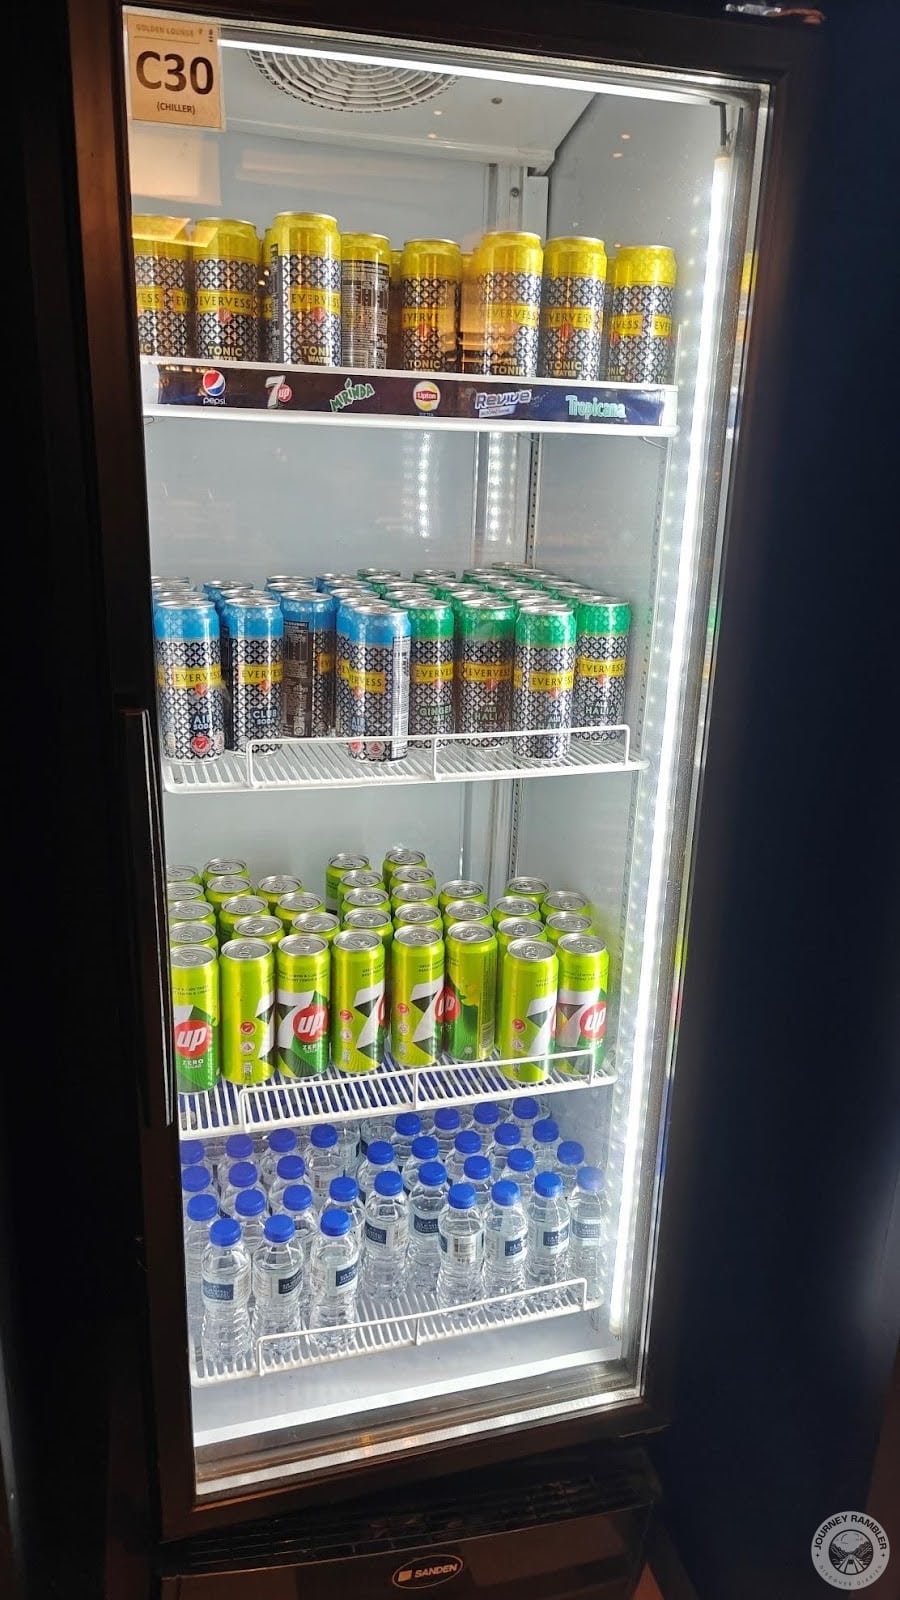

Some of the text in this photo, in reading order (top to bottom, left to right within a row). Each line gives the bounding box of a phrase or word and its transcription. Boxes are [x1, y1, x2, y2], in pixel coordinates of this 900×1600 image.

[136, 23, 165, 34] GOLDEN
[166, 27, 194, 38] LOUNGE
[135, 50, 214, 95] C30
[156, 102, 196, 116] (CHILLER)
[207, 345, 242, 357] TONIC
[409, 359, 441, 369] TONIC
[549, 360, 582, 371] TONIC
[203, 396, 226, 406] pepsi
[329, 382, 376, 413] MIRINDA
[417, 391, 437, 401] Lipton
[475, 389, 532, 409] Revive
[565, 394, 627, 420] Tropicana
[414, 1563, 458, 1578] SANDEN
